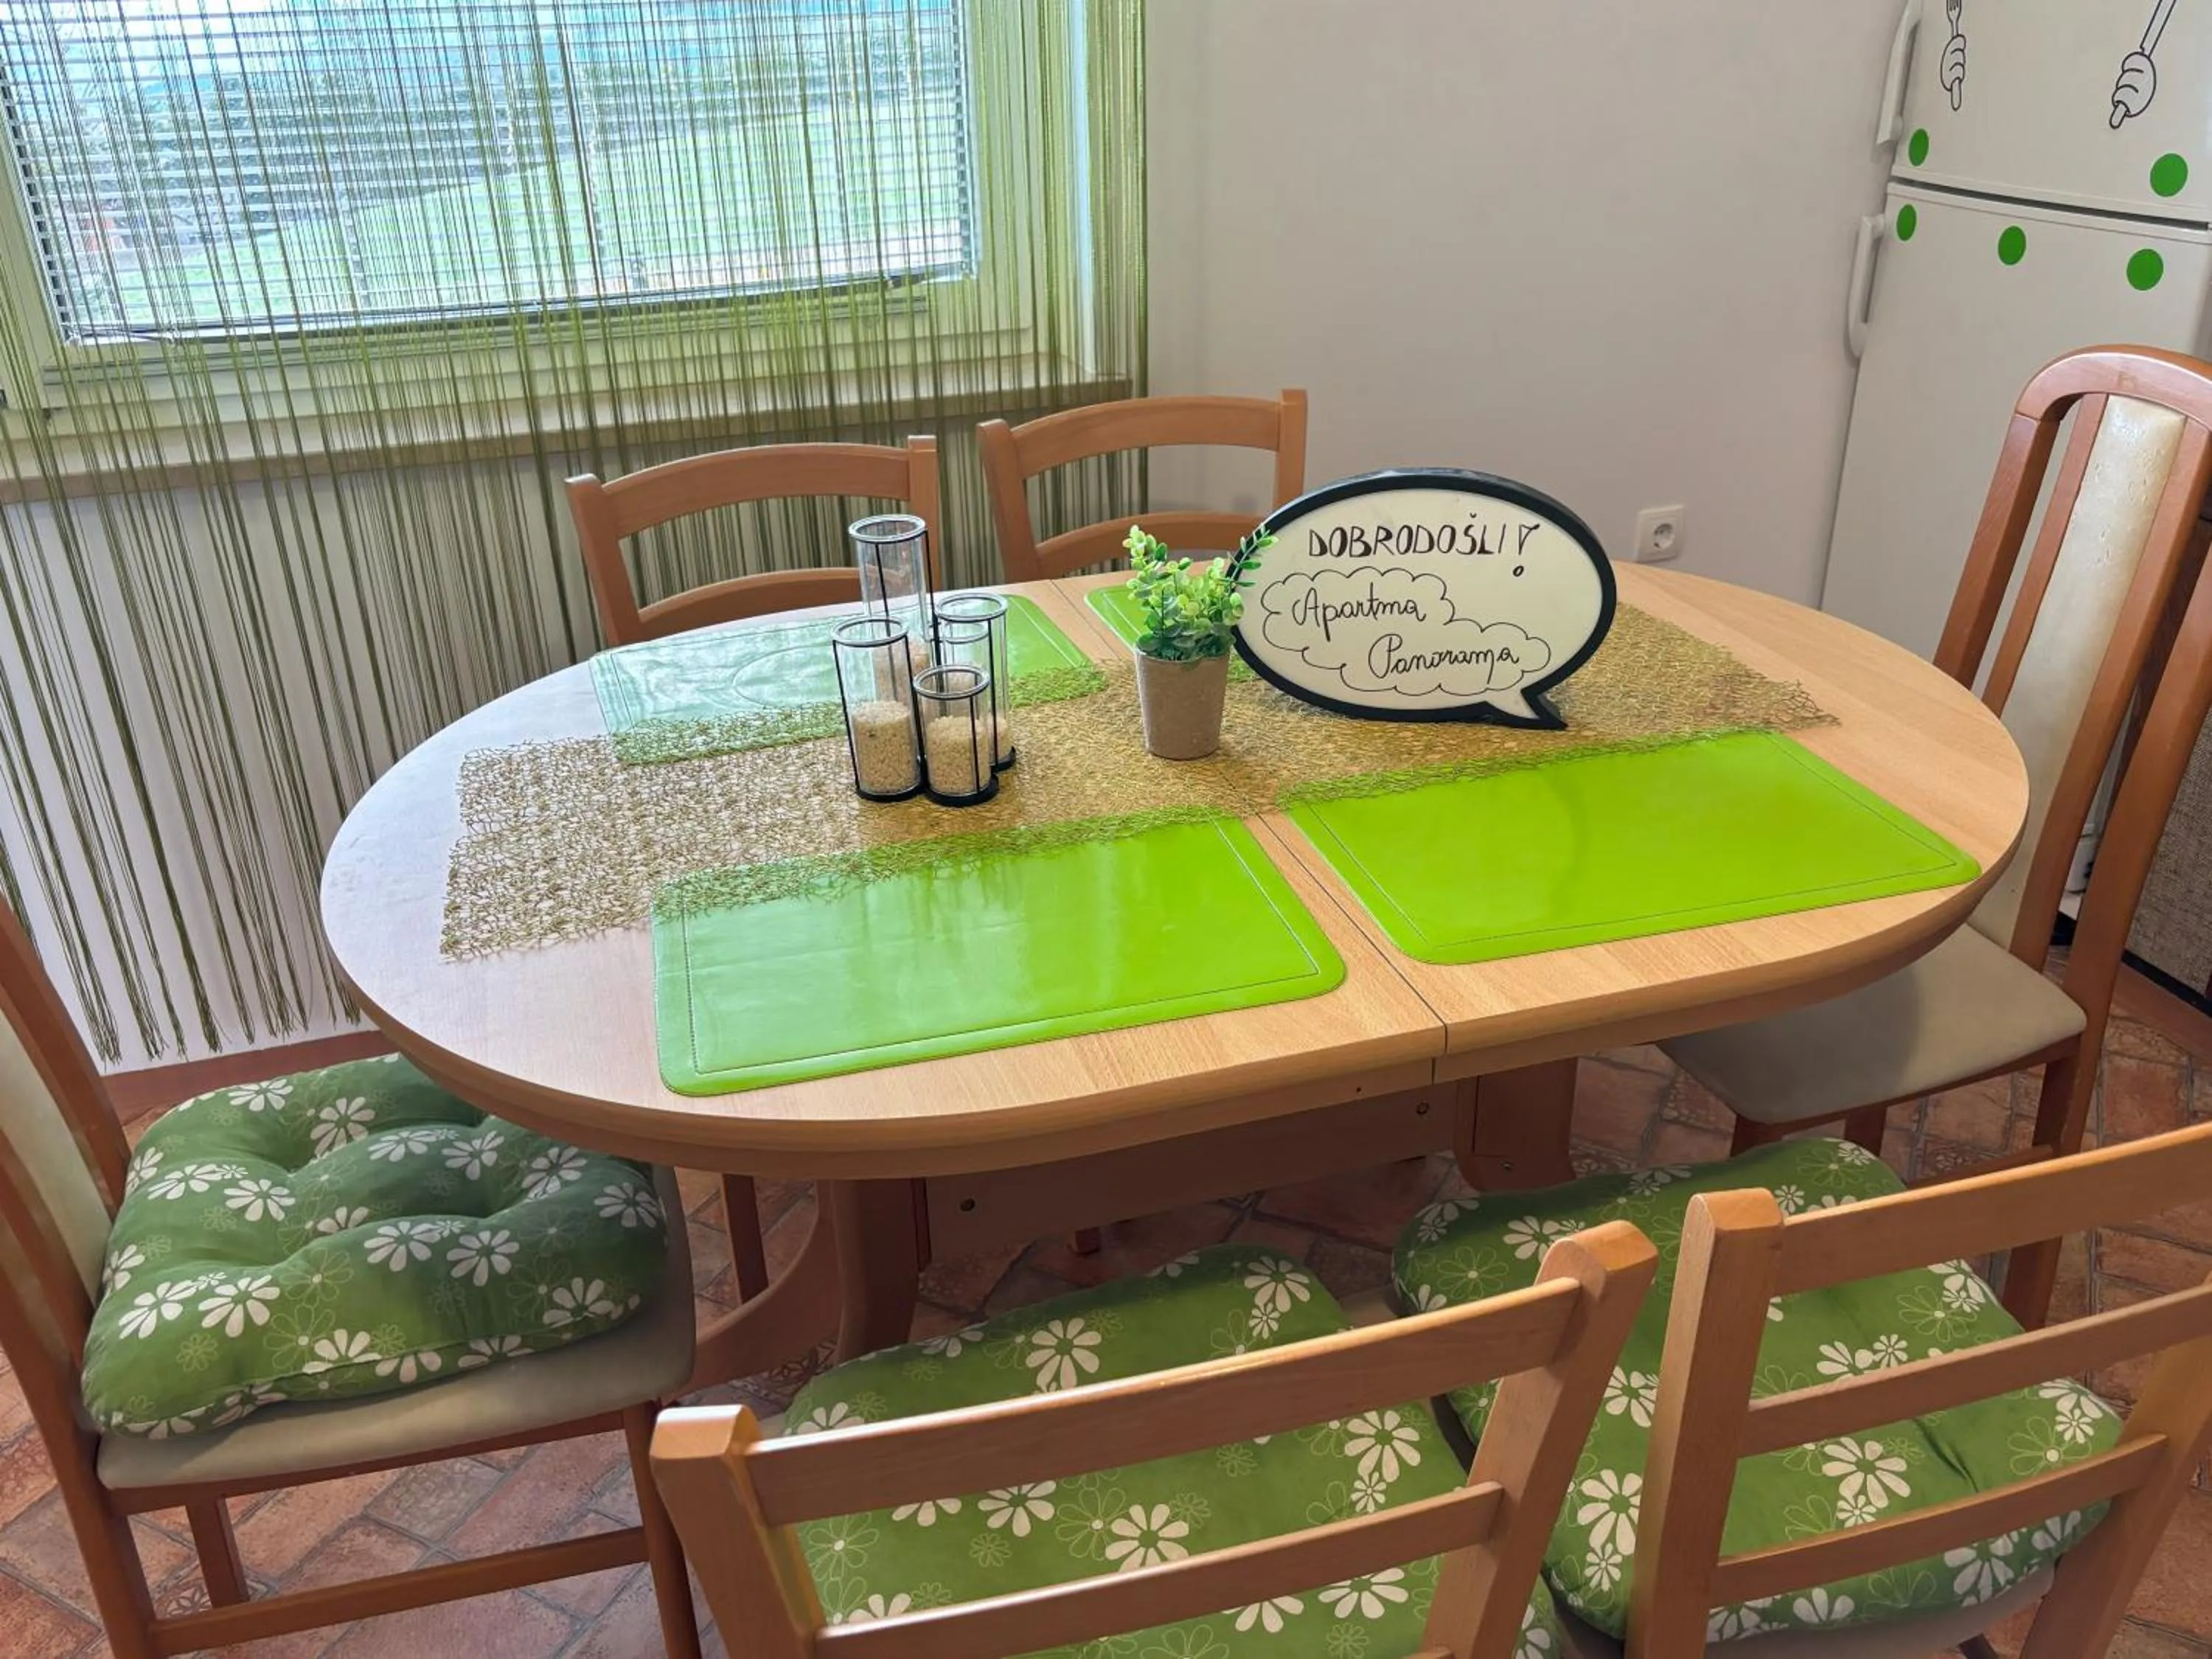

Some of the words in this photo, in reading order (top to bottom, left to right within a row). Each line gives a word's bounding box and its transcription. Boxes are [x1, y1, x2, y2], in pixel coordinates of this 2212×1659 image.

[1309, 512, 1540, 577] DOBRODOŠLI!
[1293, 582, 1427, 641] Apartma
[1369, 634, 1520, 684] Panorama
